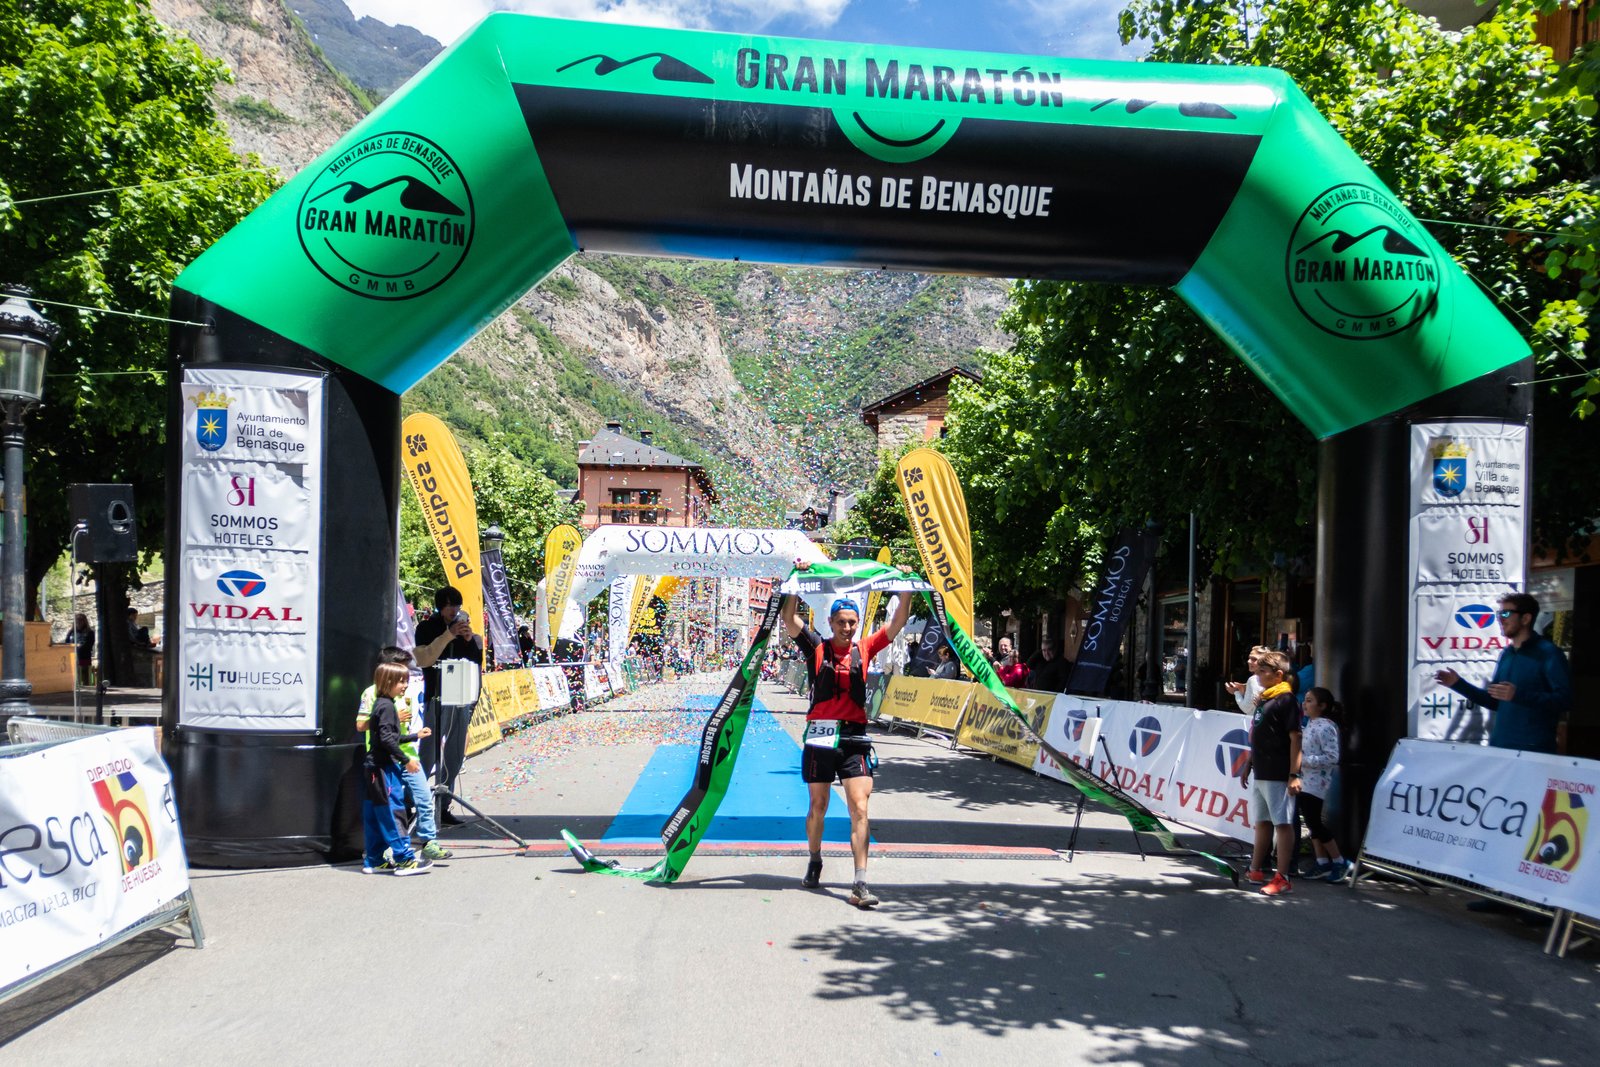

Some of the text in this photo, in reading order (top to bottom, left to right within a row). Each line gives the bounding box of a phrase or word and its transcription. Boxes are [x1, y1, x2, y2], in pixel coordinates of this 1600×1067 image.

[735, 47, 1064, 108] GRAN MARATÓN
[328, 137, 455, 181] MONTAÑAS DE BENASQUE
[730, 163, 1053, 219] MONTAÑAS DE BENASQUE
[1309, 188, 1359, 221] MONTAÑAS
[1360, 189, 1372, 201] DE
[304, 207, 466, 247] GRAN MARATÓN
[1294, 257, 1436, 283] GRAN MARATÓN
[236, 412, 306, 426] Ayuntamiento
[236, 424, 283, 438] Villa de
[236, 437, 305, 453] Benasque
[1475, 471, 1498, 482] Villa
[210, 514, 279, 530] SOMMOS
[214, 532, 274, 546] HOTELES
[626, 528, 775, 556] SOMMOS
[1447, 552, 1504, 565] SOMMOS
[1451, 569, 1501, 580] HOTELES
[1083, 545, 1130, 651] SOMMOS
[1109, 578, 1134, 623] BODEGA
[189, 603, 303, 622] VIDAL
[947, 620, 992, 683] MARATÓN
[217, 670, 304, 686] TUHUESCA
[700, 687, 741, 765] MONTAÑAS DE BENASQUE
[809, 726, 835, 737] 330
[1176, 781, 1253, 829] VIDA
[0, 811, 108, 889] esca
[1518, 860, 1531, 875] DE
